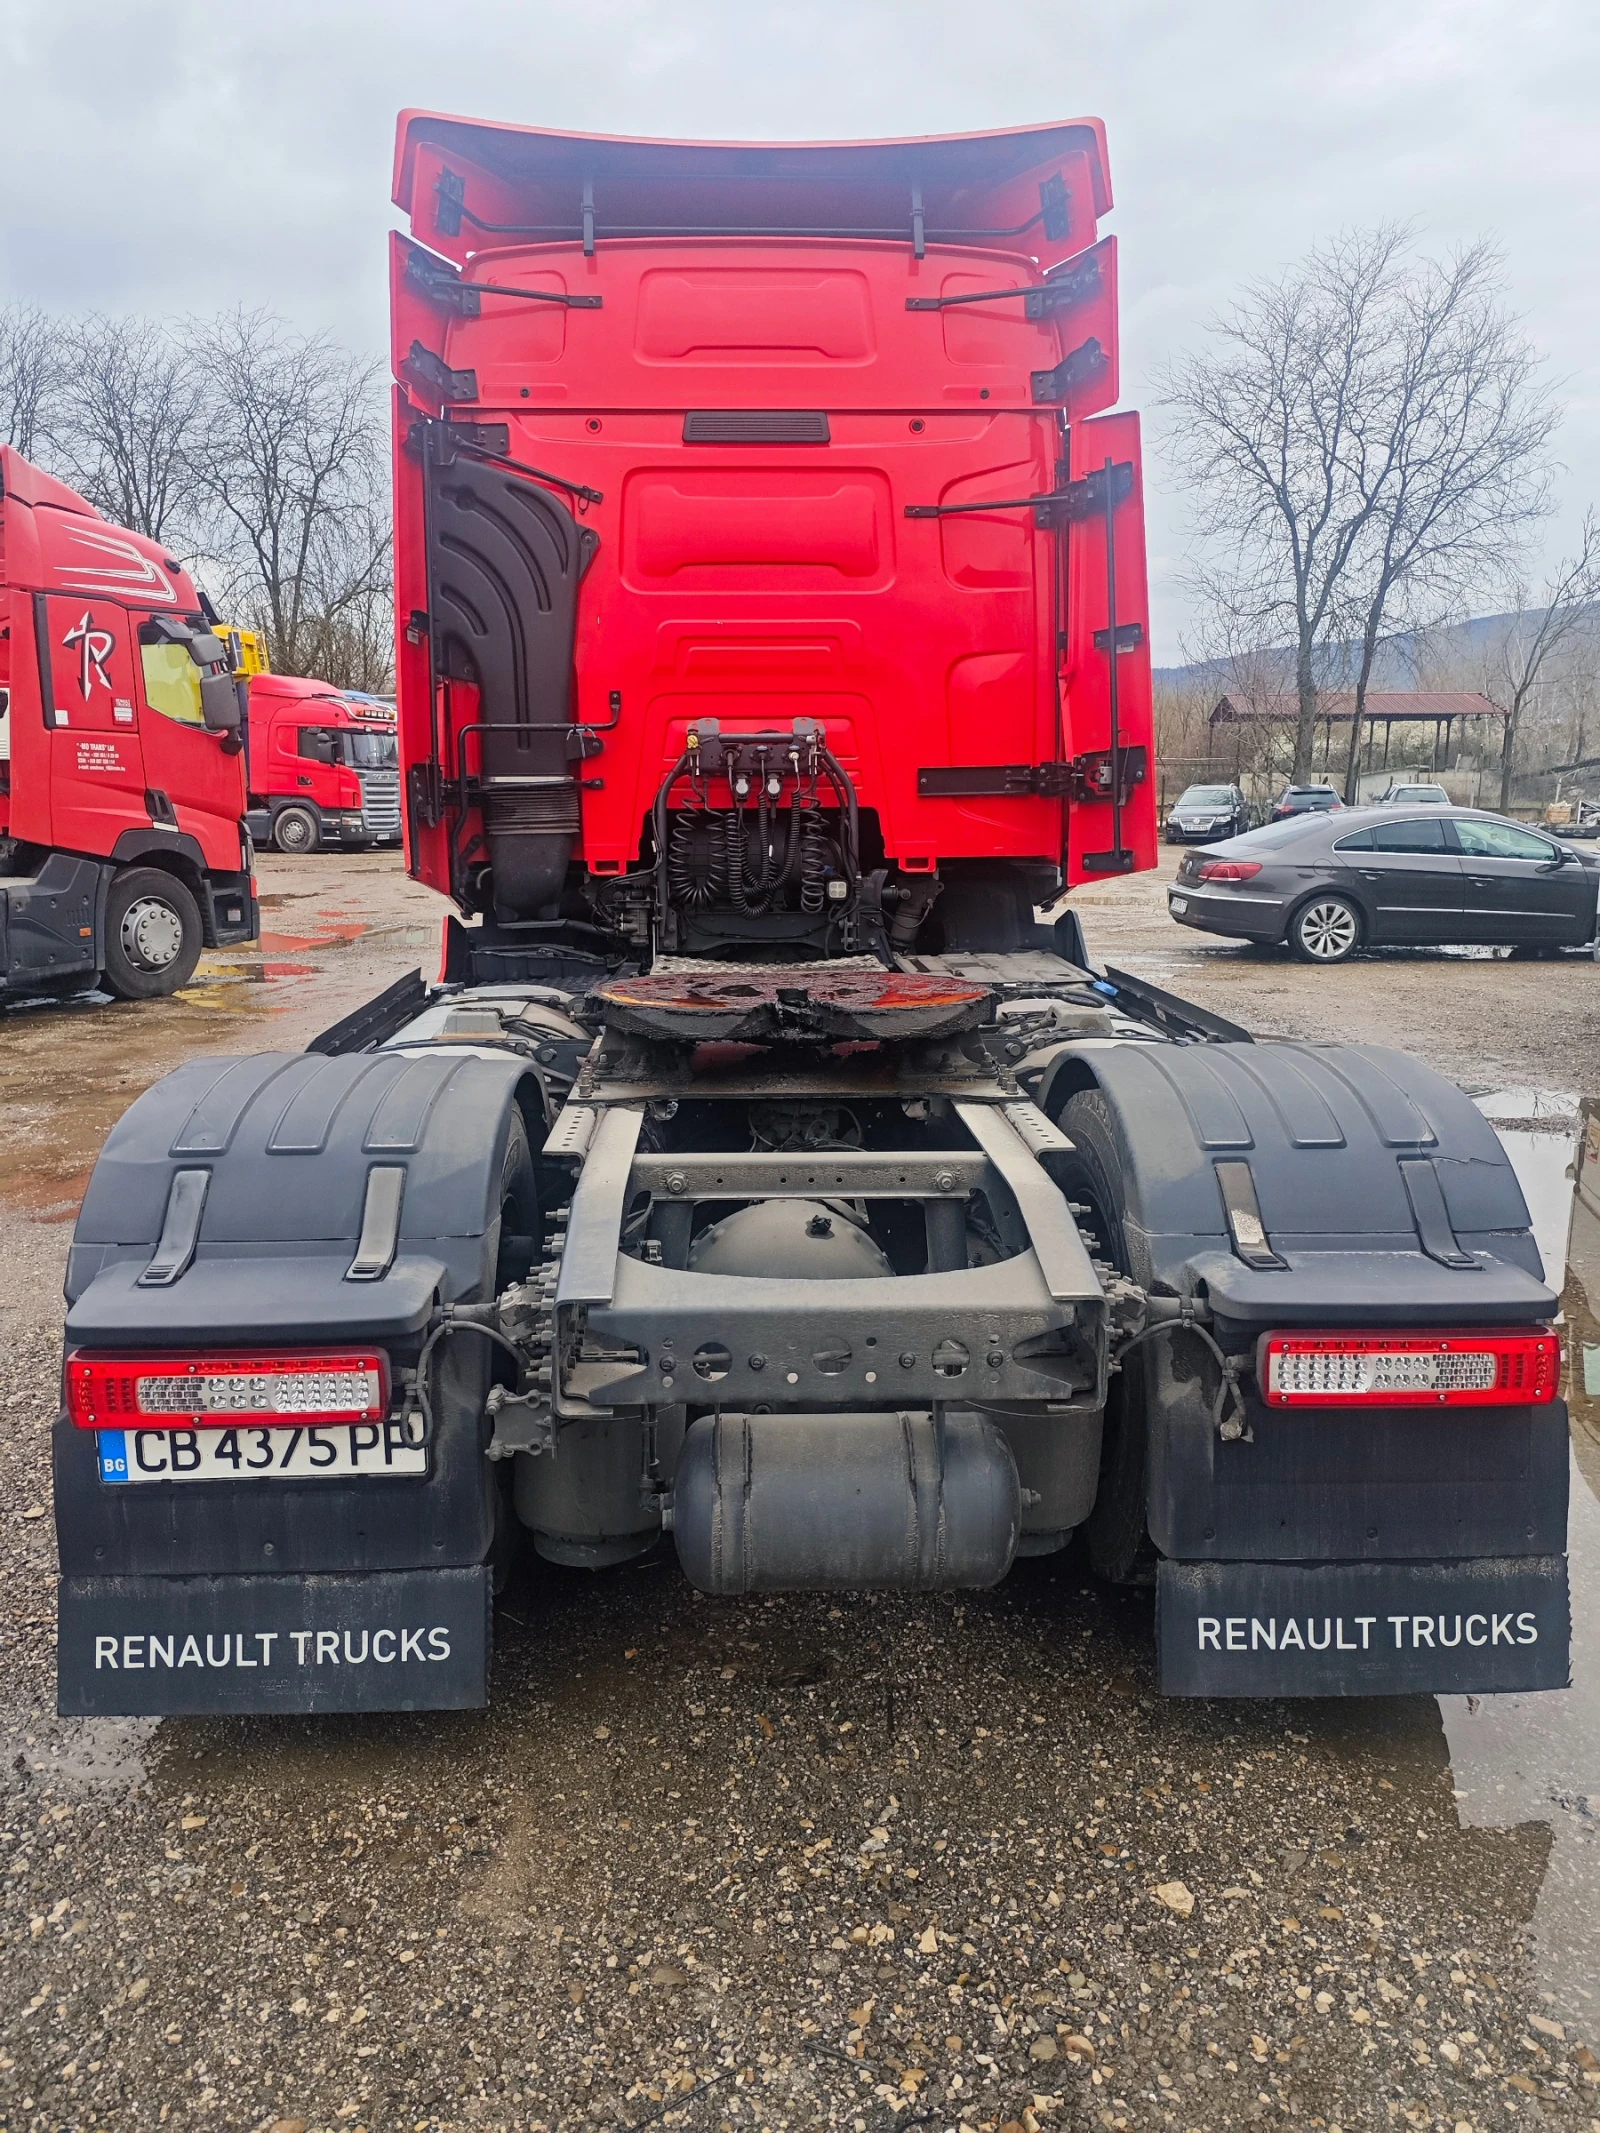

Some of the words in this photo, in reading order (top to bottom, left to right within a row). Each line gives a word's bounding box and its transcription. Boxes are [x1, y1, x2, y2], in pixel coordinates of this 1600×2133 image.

[103, 1458, 126, 1473] BG
[134, 1429, 202, 1472] CB
[214, 1427, 337, 1469] 4375
[95, 1632, 278, 1669] RENAULT
[289, 1627, 451, 1666] TRUCKS
[1198, 1617, 1377, 1651] RENAULT
[1387, 1612, 1539, 1648] TRUCKS
